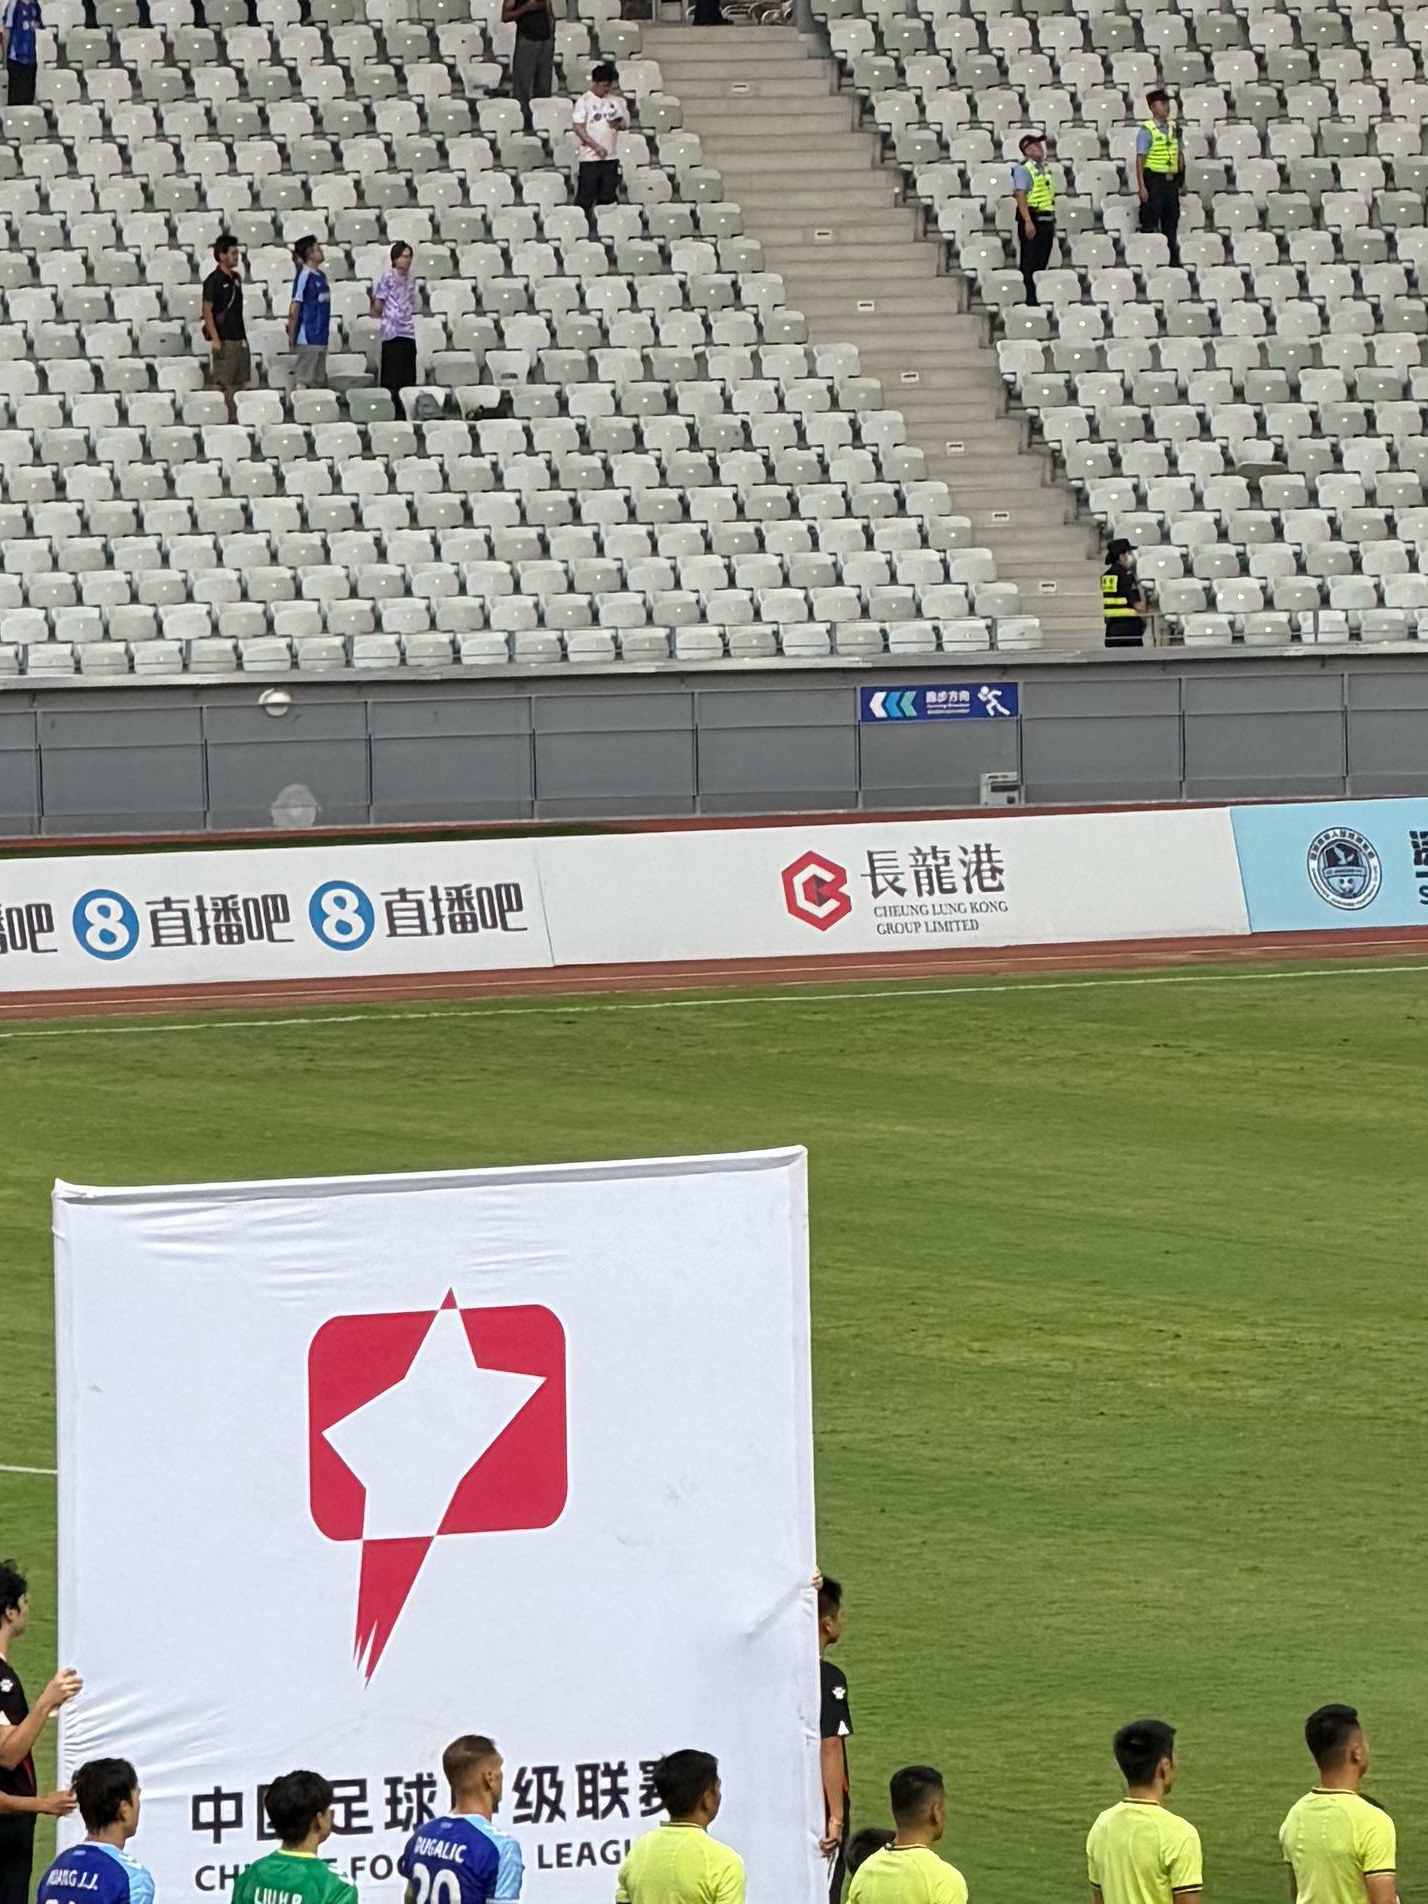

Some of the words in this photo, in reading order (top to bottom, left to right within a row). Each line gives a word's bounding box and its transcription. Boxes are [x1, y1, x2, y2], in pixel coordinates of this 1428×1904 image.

[860, 842, 1006, 898] 長龍港
[873, 904, 930, 918] CHEUNG
[932, 902, 968, 917] LUNG
[969, 900, 1010, 915] KONG
[876, 921, 924, 937] GROUP
[925, 918, 980, 935] LIMITED
